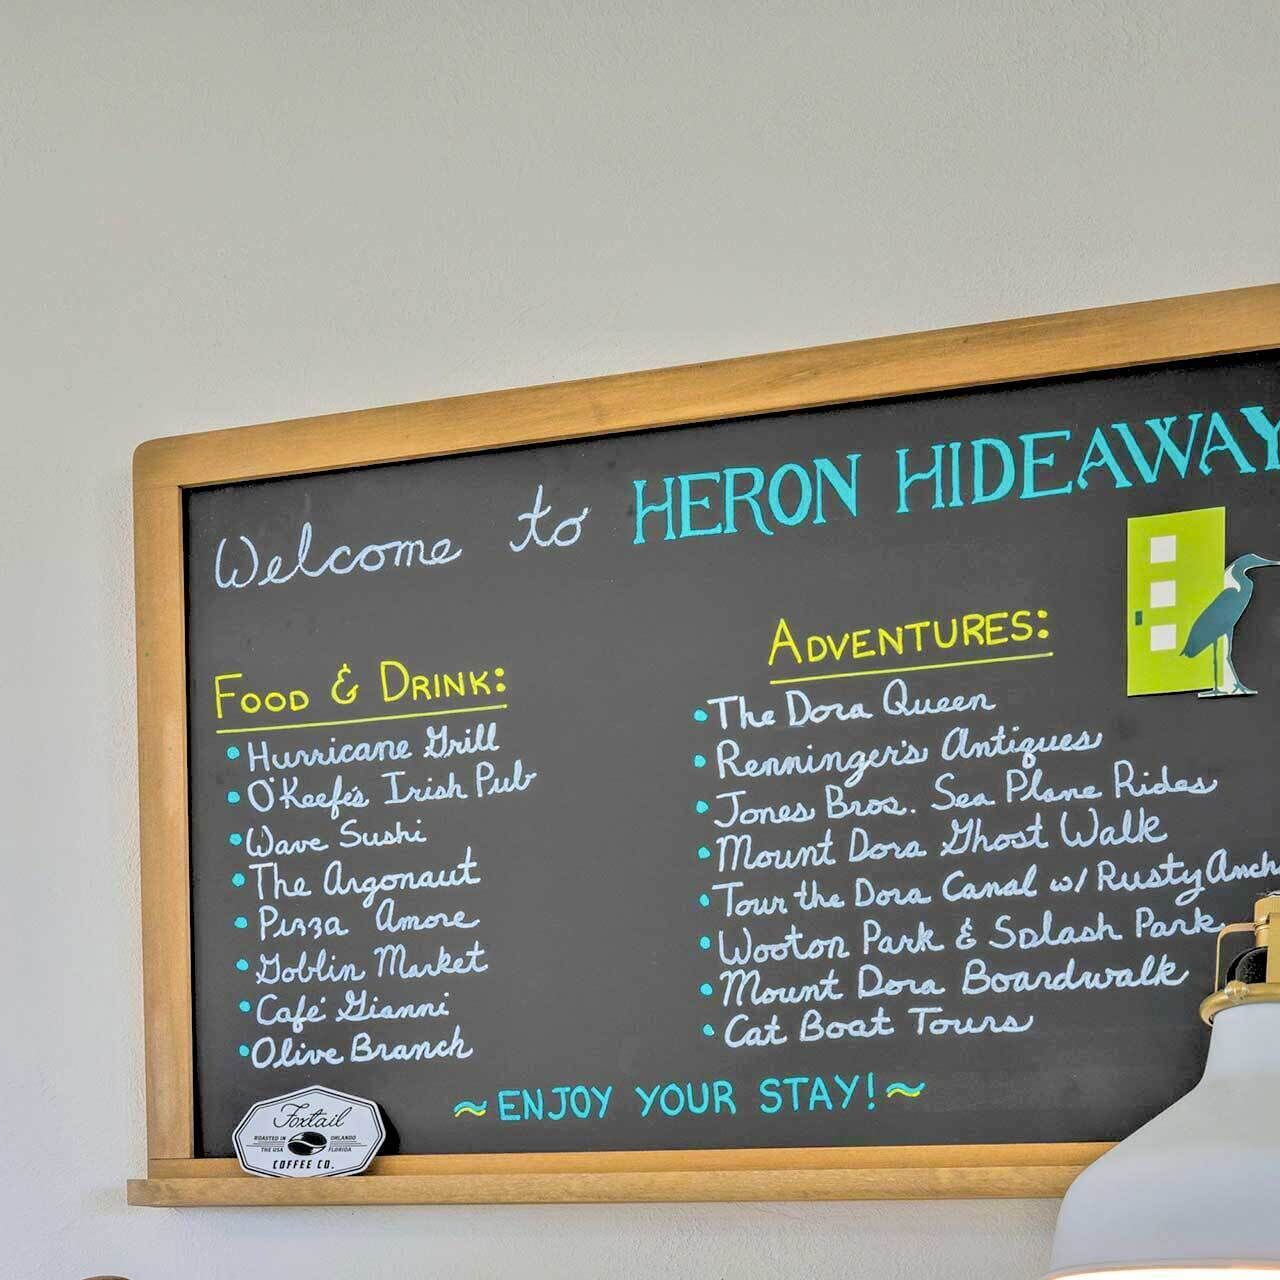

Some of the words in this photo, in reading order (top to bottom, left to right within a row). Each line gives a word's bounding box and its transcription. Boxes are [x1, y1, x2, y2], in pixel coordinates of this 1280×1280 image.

[214, 522, 462, 589] Welcome
[509, 483, 591, 553] to
[632, 454, 862, 544] HERON
[768, 609, 1049, 667] ADVENTURES:
[214, 672, 310, 719] FOOD
[331, 663, 359, 704] &
[707, 696, 776, 730] The
[785, 689, 874, 727] Dora
[882, 678, 997, 716] Queen
[247, 737, 412, 771] Hurricane
[424, 722, 500, 759] Grill
[716, 739, 929, 789] Renninger's
[941, 725, 1103, 769] Antiques
[381, 771, 468, 804] Irish
[476, 760, 537, 797] Pub
[713, 790, 816, 828] Jones
[825, 784, 916, 820] Bros.
[931, 772, 995, 811] Sea
[1006, 768, 1103, 803] Plane
[1113, 760, 1218, 799] Rides
[246, 825, 329, 857] Wave
[339, 819, 427, 848] Sushi
[716, 828, 836, 872] Mount
[847, 827, 927, 863] Dora
[940, 812, 1049, 857] Ghost
[1060, 806, 1168, 848] Walk
[249, 862, 311, 900] The
[324, 846, 480, 908] Argonaut
[711, 881, 788, 918] Tour
[793, 879, 845, 911] the
[854, 878, 932, 907] Dora
[941, 864, 1038, 902] Canal
[1049, 867, 1089, 894] w/
[1096, 852, 1205, 906] Rusty
[259, 905, 349, 941] Pizza
[375, 898, 480, 933] Amore
[718, 923, 850, 966] Wooton
[862, 919, 945, 955] Park
[955, 917, 977, 950] &
[989, 910, 1122, 951] Splash
[1135, 906, 1225, 938] Park
[256, 949, 366, 984] Goblin
[374, 940, 488, 979] Market
[719, 968, 844, 1008] Mount
[857, 963, 946, 1000] Dora
[962, 953, 1190, 995] Boardwalk
[256, 994, 326, 1033] Café
[336, 990, 449, 1022] Gianni
[723, 1013, 788, 1048] Cat
[799, 1006, 895, 1042] Boat
[907, 1006, 1034, 1036] Tours
[251, 1036, 344, 1069] Olive
[351, 1024, 473, 1062] Branch
[273, 1103, 353, 1128] Foxtail
[497, 1085, 613, 1121] ENJOY
[635, 1080, 737, 1117] YOUR
[759, 1072, 876, 1114] STAY!
[273, 1159, 312, 1170] COFFEE
[317, 1159, 335, 1170] CO.
